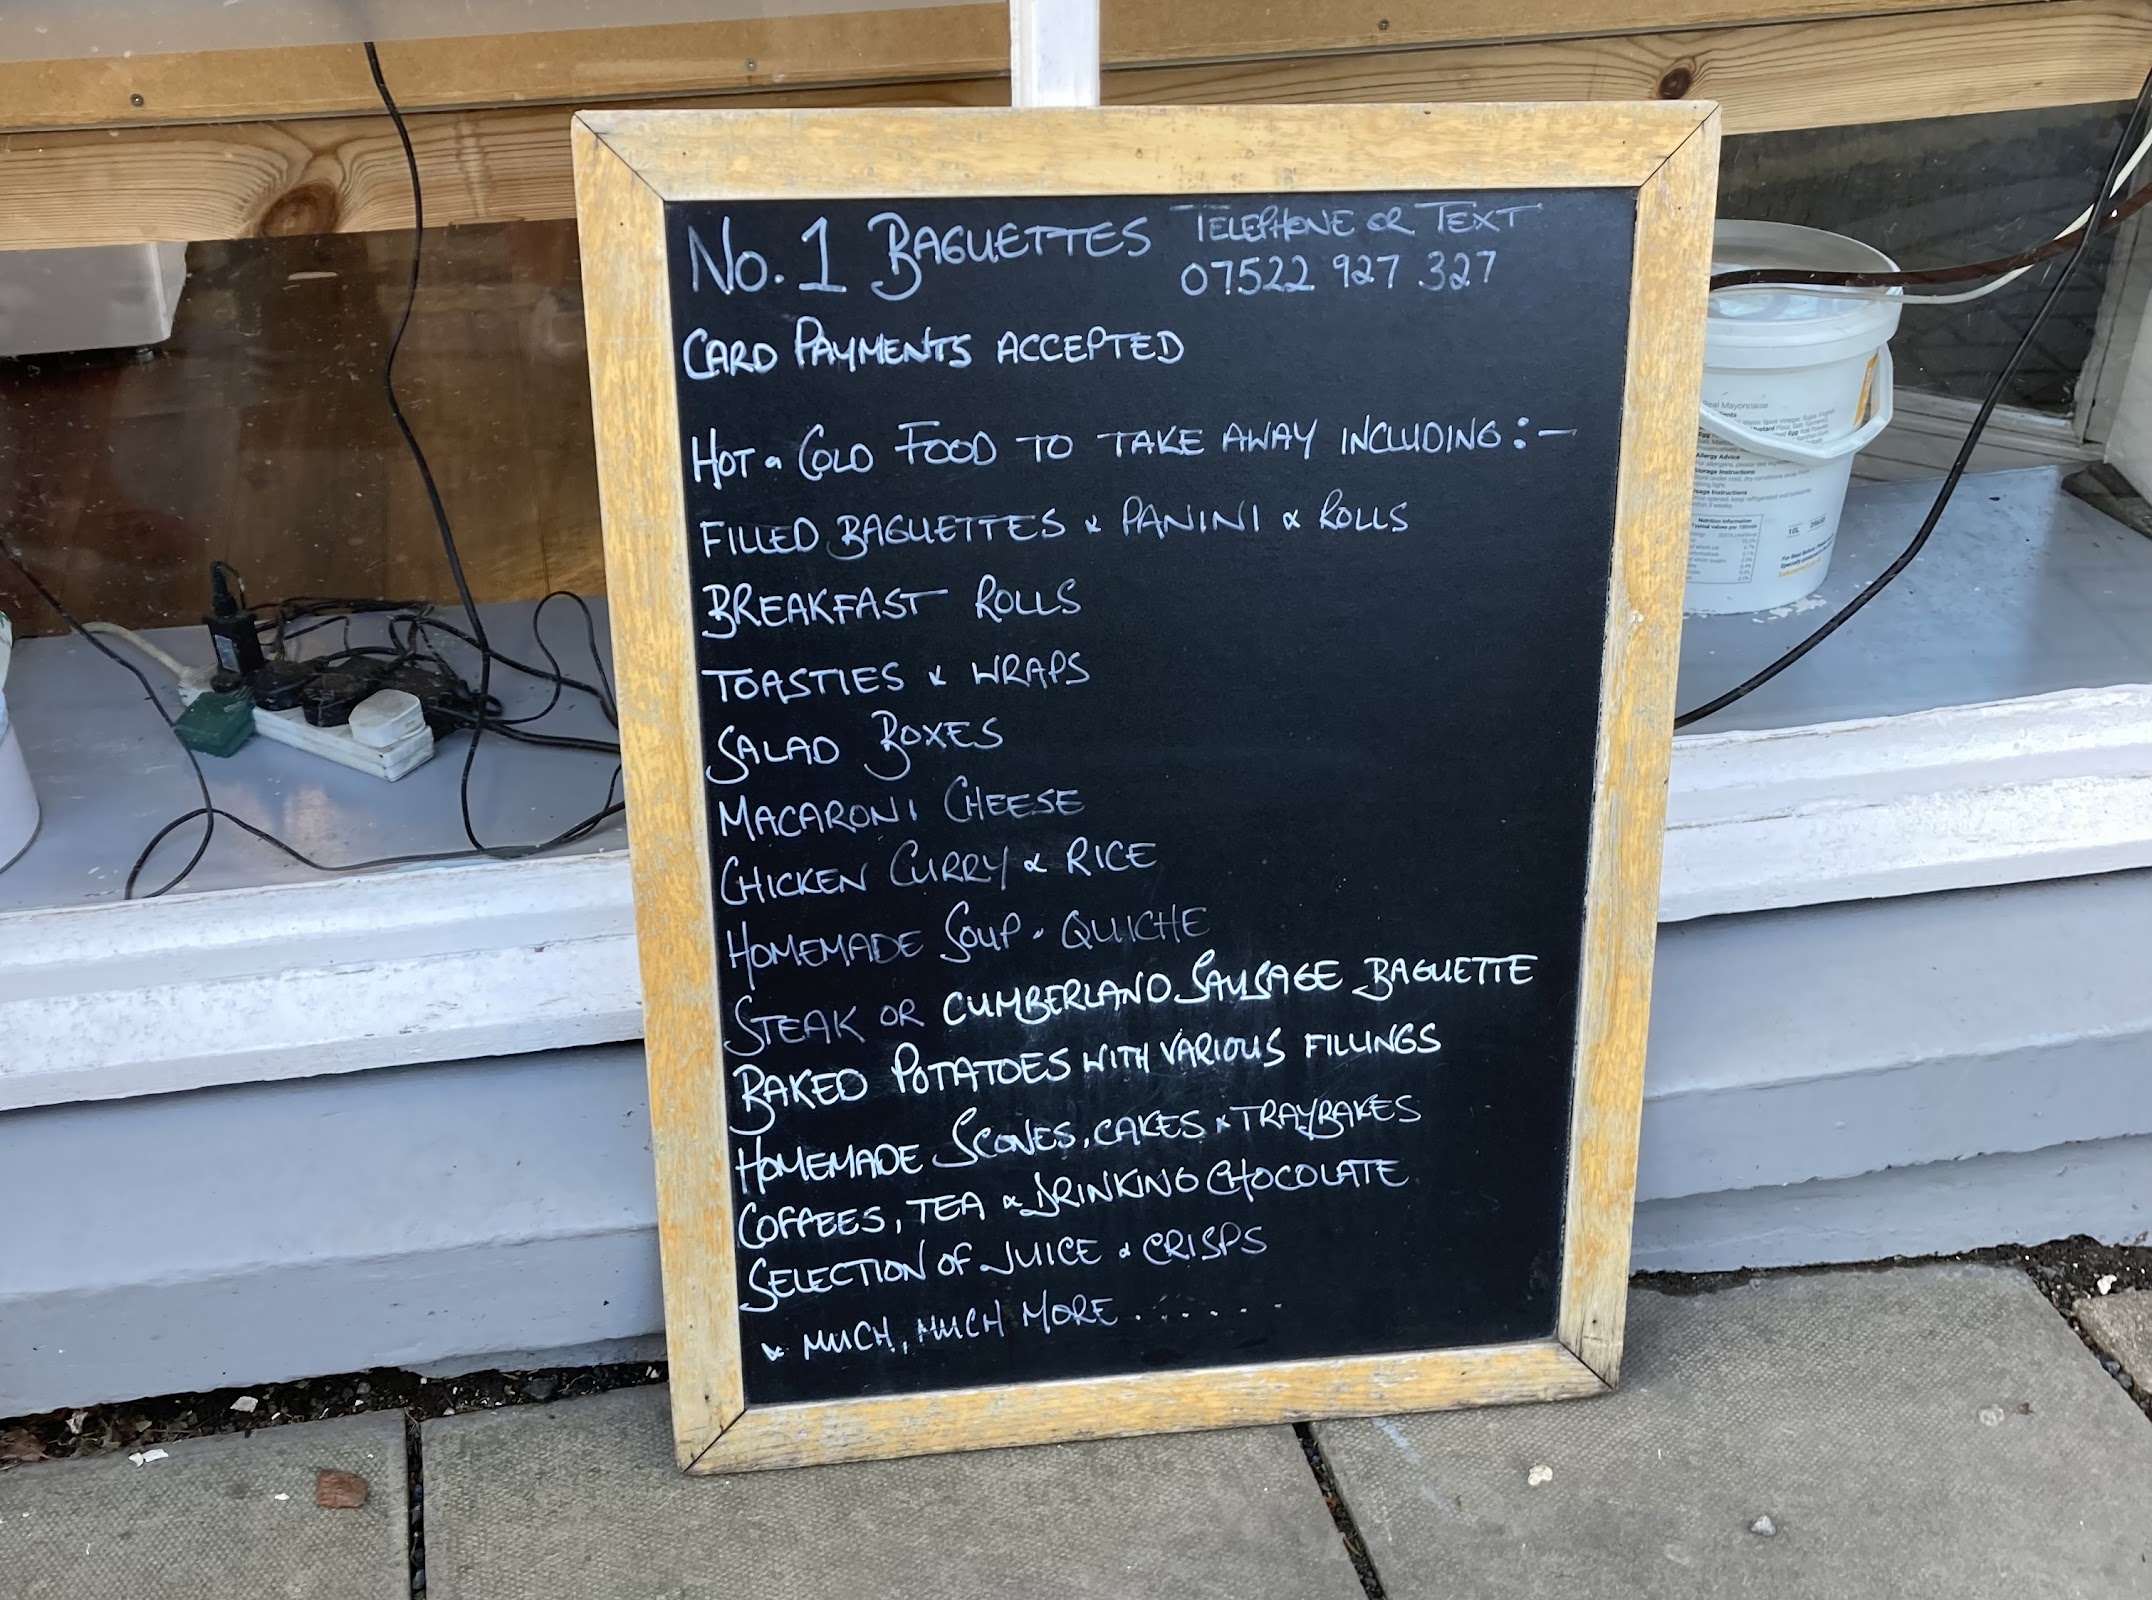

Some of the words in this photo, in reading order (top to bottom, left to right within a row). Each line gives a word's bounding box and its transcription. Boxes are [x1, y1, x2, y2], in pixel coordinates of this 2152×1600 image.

[1170, 205, 1354, 242] TELEPHONE
[1367, 207, 1415, 235] OR
[1415, 202, 1542, 233] TEXT
[688, 216, 784, 295] No.
[799, 217, 847, 292] 1
[868, 212, 1151, 301] BAGUETTES
[1181, 255, 1315, 296] 07522
[1333, 254, 1399, 289] 927
[1419, 251, 1496, 291] 327
[684, 328, 778, 380] CARD
[794, 316, 972, 372] PAYMENTS
[997, 326, 1184, 364] ACCEPTED
[1698, 431, 1711, 439] Egg
[1721, 401, 1769, 411] Mayonnaise
[692, 428, 755, 490] HOT
[895, 421, 997, 465] FOOD
[1016, 434, 1073, 462] TO
[1097, 425, 1204, 457] TAKE
[1223, 419, 1318, 460] AWAY
[1695, 467, 1718, 475] Storage
[700, 517, 819, 558] FILLED
[827, 508, 1066, 560] BAGUETTES
[1123, 496, 1259, 539] PANINI
[1319, 489, 1408, 532] ROLLS
[1788, 527, 1800, 535] 10L
[702, 583, 948, 639] BREAKFAST
[975, 574, 1081, 623] ROLLS
[702, 662, 904, 704] TOASTIES
[972, 650, 1090, 689] WRAPS
[705, 725, 839, 784] SALAD
[864, 710, 1003, 781] BOXES
[719, 795, 917, 840] MACARONI
[944, 775, 1084, 822] CHEESE
[721, 856, 867, 905] CHICKEN
[890, 840, 1008, 891] CURRY
[1066, 837, 1156, 876] RICE
[727, 921, 923, 991] HOMEMADE
[940, 900, 1021, 963] SOUP
[1062, 904, 1210, 950] QUICHE
[724, 995, 865, 1056] STEAK
[880, 999, 925, 1027] OR
[943, 971, 1171, 1026] CUMBERLAND
[1174, 949, 1343, 1004] SAUSAGE
[1352, 954, 1538, 1001] BAGUETTE
[729, 1064, 868, 1135] BAKED
[891, 1042, 1071, 1094] POTATOES
[1083, 1042, 1150, 1076] WITH
[1160, 1027, 1285, 1069] VARIOUS
[1304, 1023, 1441, 1059] FILLINGS
[736, 1136, 923, 1194] HOMEMADE
[1094, 1110, 1207, 1146] CAKES
[1229, 1094, 1421, 1141] TRAYBAKES
[905, 1191, 985, 1225] TEA
[1020, 1167, 1199, 1217] DRINKING
[1207, 1158, 1409, 1202] CHOCOLATE
[740, 1239, 926, 1312] SELECTION
[937, 1242, 972, 1276] OF
[980, 1236, 1102, 1275] JUICE
[1143, 1222, 1267, 1265] CRISPS
[917, 1299, 1004, 1343] MUCH
